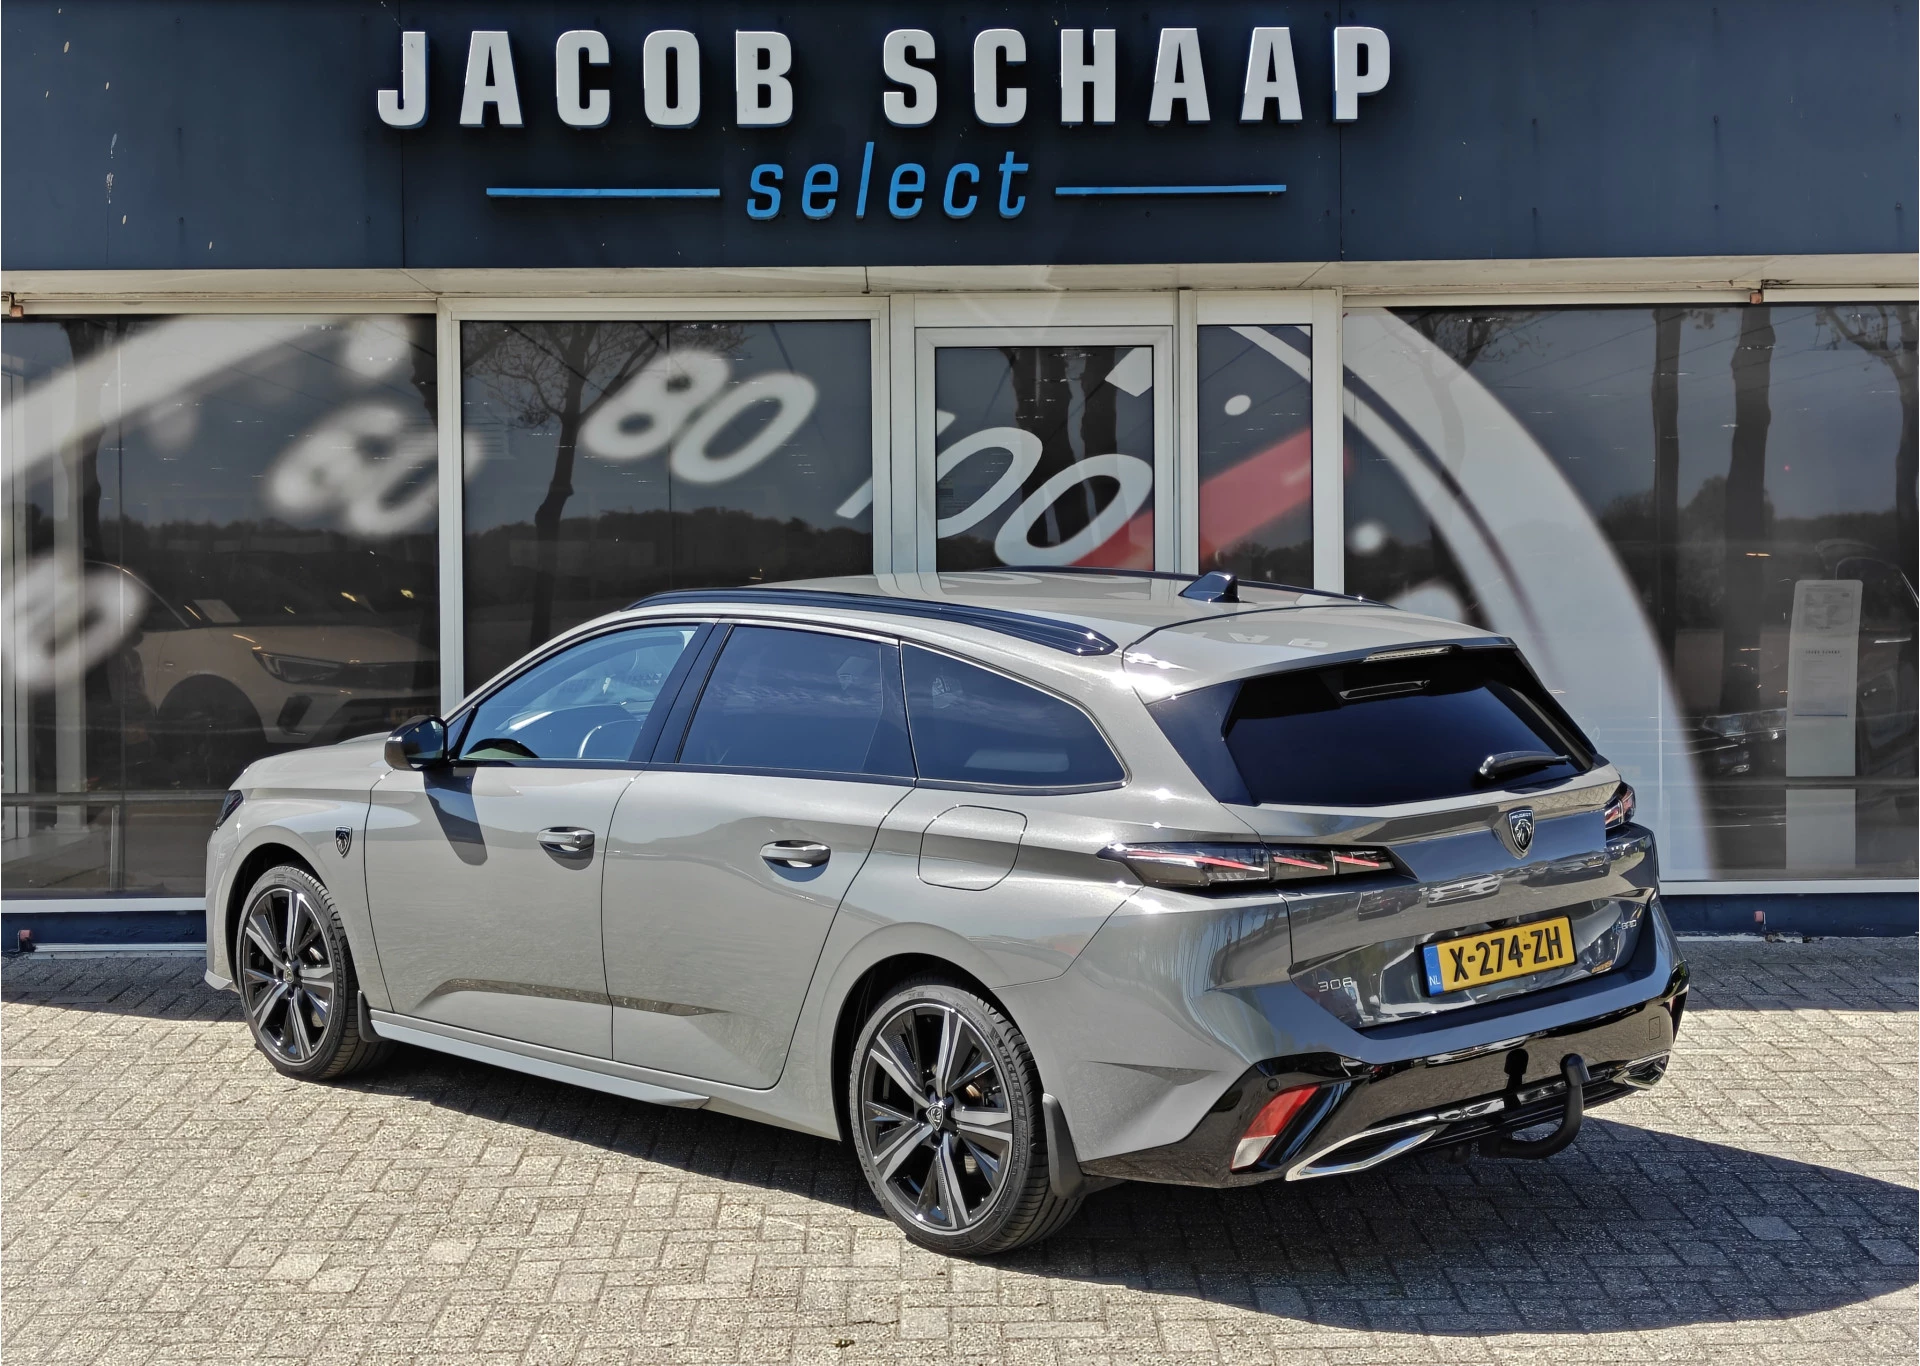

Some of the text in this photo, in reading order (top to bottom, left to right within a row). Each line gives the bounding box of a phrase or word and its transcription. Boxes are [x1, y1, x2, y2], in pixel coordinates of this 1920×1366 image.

[378, 26, 1390, 127] JACOB SCHAAP
[747, 142, 1029, 220] select
[586, 348, 815, 482] 80
[1317, 976, 1353, 992] 308
[1429, 974, 1441, 986] NL
[1449, 926, 1563, 982] X-274-ZH
[999, 1045, 1026, 1120] MICHELIN
